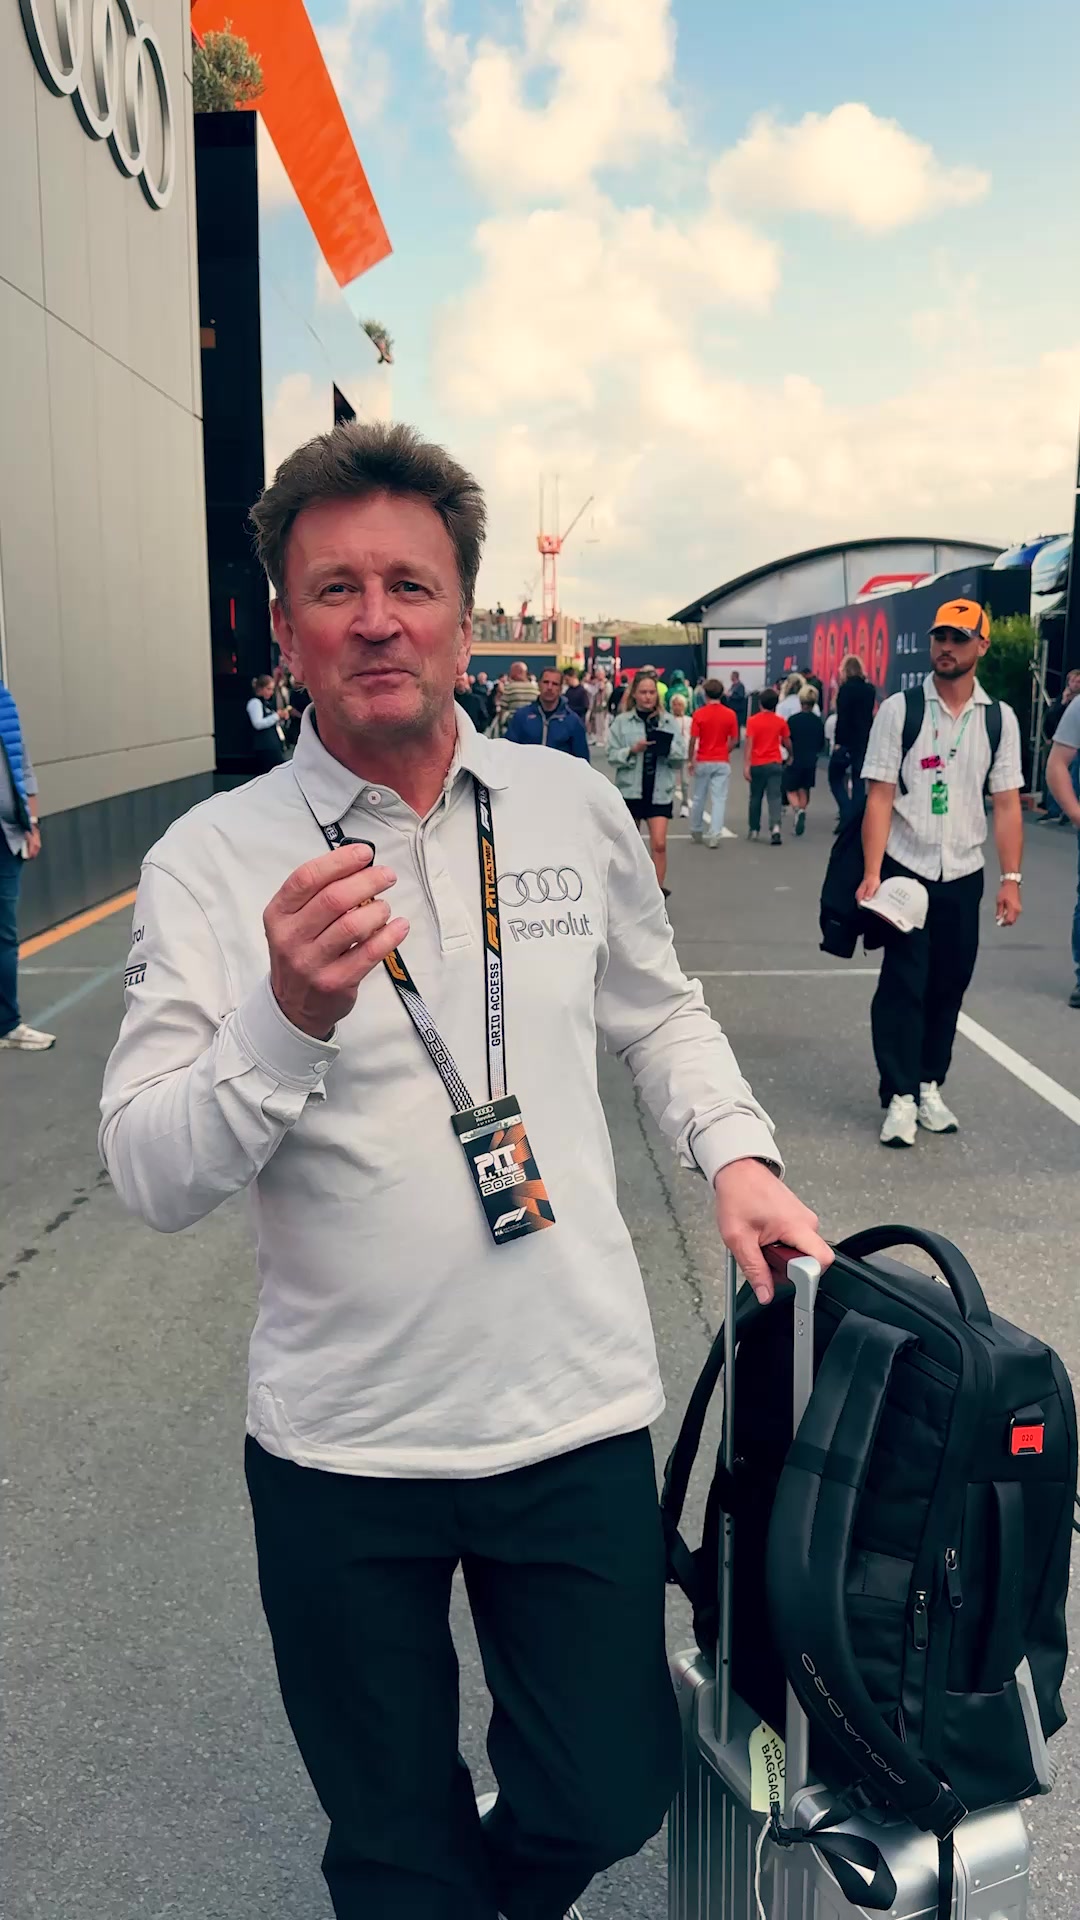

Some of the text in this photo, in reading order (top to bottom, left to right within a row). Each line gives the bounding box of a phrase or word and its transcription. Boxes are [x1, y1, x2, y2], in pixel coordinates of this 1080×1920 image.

[132, 925, 145, 944] rol
[507, 911, 594, 943] Revolut
[489, 962, 501, 1046] GRID ACCESS
[422, 1027, 453, 1077] 2026
[473, 1143, 517, 1178] PIT
[479, 1162, 521, 1184] ALL TIME
[481, 1170, 527, 1197] 2026
[493, 1206, 527, 1230] F1
[1021, 1434, 1034, 1442] 020
[801, 1652, 907, 1785] PIQUADRO
[770, 1737, 786, 1778] HOLD
